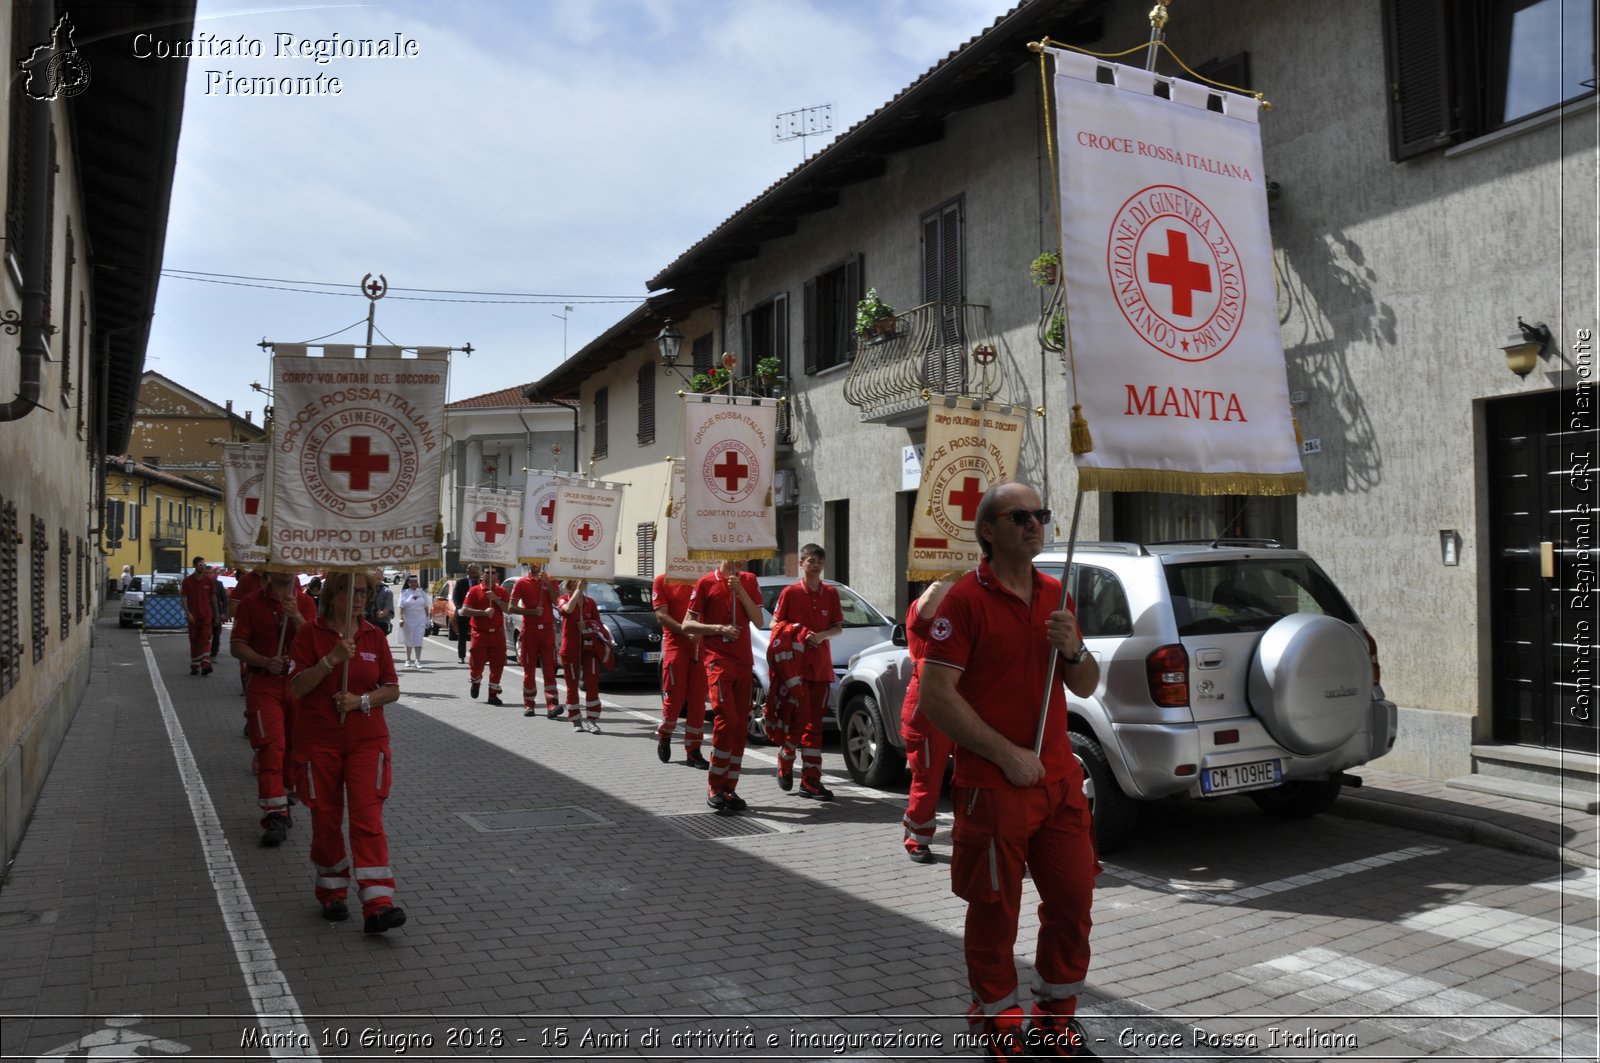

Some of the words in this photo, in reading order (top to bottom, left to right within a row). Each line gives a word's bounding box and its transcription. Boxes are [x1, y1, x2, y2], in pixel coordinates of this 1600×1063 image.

[1077, 130, 1134, 154] CROCE
[1138, 141, 1184, 164] ROSSA
[1186, 152, 1253, 182] ITALIANA
[1128, 199, 1153, 226] DI
[1148, 192, 1212, 236] GINEVRA
[1210, 236, 1231, 258] 22
[1114, 218, 1177, 348] CONVENZIONE
[1218, 261, 1240, 335] AGOSTO
[1191, 325, 1225, 354] 1864
[282, 371, 314, 385] CORPO
[317, 371, 370, 385] VOLONTARI
[373, 372, 392, 385] DEL
[394, 372, 441, 385] SOCCORSO
[1124, 383, 1248, 423] MANTA
[281, 401, 321, 455] CROCE
[320, 387, 382, 410] ROSSA
[384, 390, 438, 453] ITALIANA
[321, 419, 337, 435] DI
[340, 409, 396, 435] GINEVRA
[694, 417, 716, 445] CROCE
[714, 411, 743, 422] ROSSA
[742, 415, 767, 448] ITALIANA
[395, 432, 411, 448] 22
[302, 434, 346, 512] CONVENZIONE
[923, 445, 948, 484] CROCE
[949, 436, 988, 452] ROSSA
[987, 442, 1009, 482] ITALIAN
[397, 450, 411, 500] AGOSTO
[696, 509, 736, 518] COMITATO
[737, 510, 767, 518] LOCALE
[932, 475, 960, 537] CONVENZIONE
[948, 466, 957, 477] DI
[278, 528, 352, 544] GRUPPO
[359, 529, 376, 544] DI
[381, 524, 434, 540] MELLE
[727, 522, 736, 530] DI
[280, 545, 362, 562] COMITATO
[371, 544, 431, 560] LOCALE
[913, 550, 964, 561] COMITATO
[966, 552, 978, 561] DI
[1211, 768, 1230, 788] CM
[1235, 762, 1274, 785] 109HE
